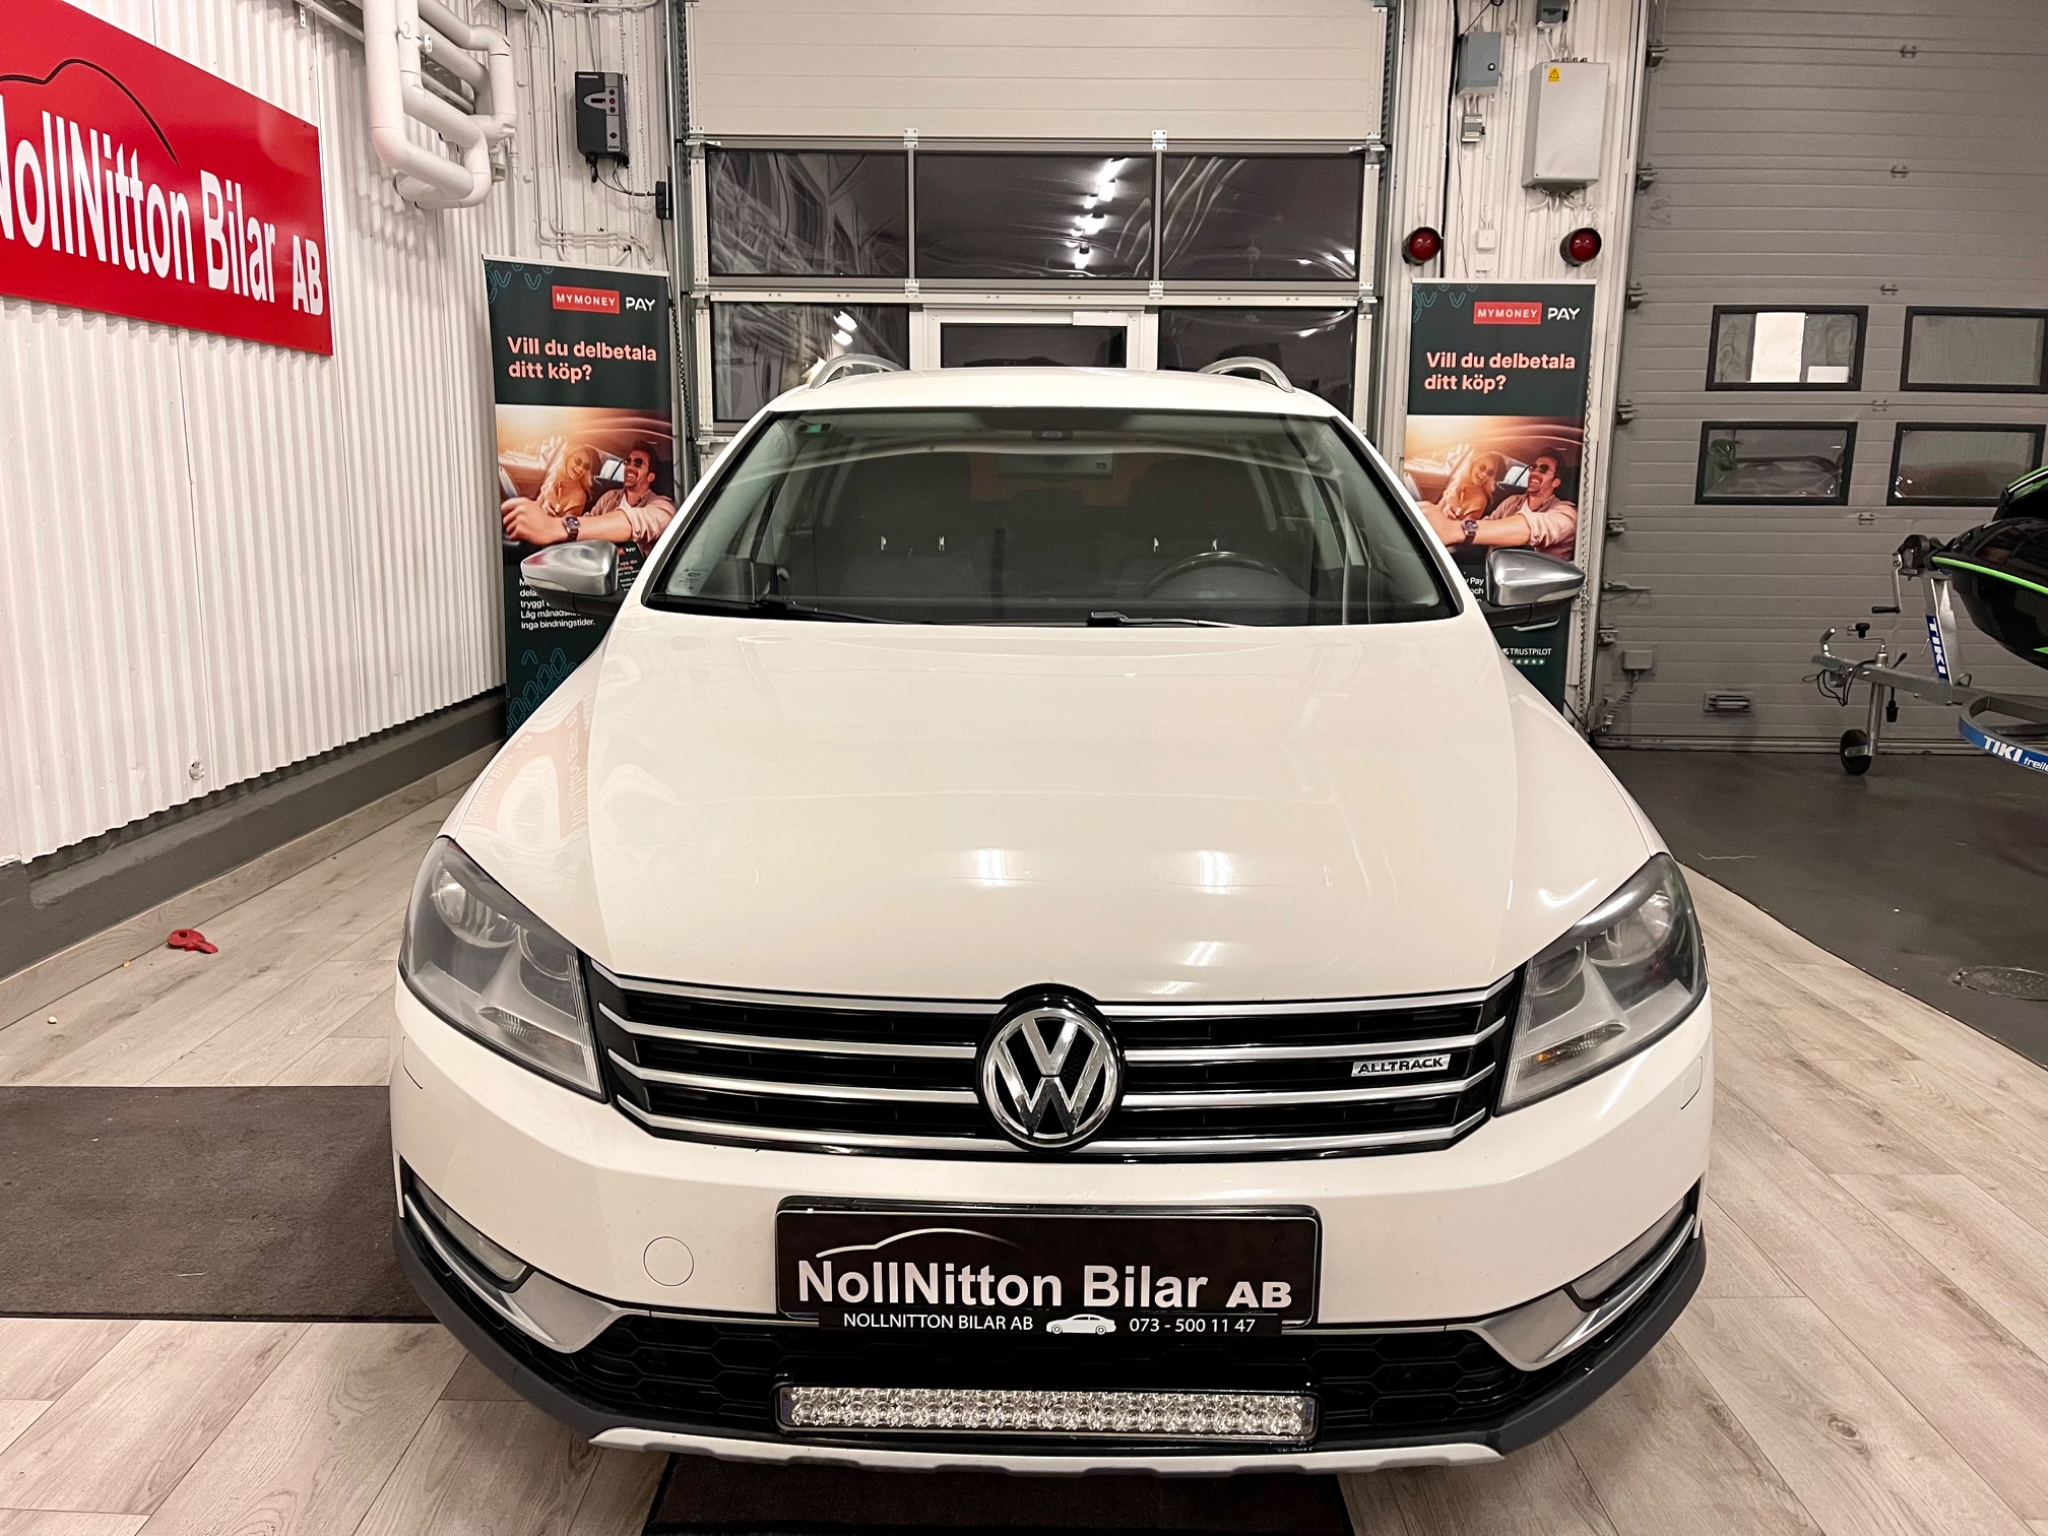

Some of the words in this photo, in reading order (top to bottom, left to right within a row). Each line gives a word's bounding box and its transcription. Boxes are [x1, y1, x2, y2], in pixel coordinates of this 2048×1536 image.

[200, 169, 277, 303] Bilar
[291, 234, 324, 316] AB
[556, 293, 616, 307] MYMONEY
[625, 296, 656, 311] PAY
[1477, 308, 1538, 318] MYMONEY
[1547, 307, 1581, 320] PAY
[507, 336, 540, 355] Vill
[544, 339, 569, 356] du
[573, 340, 657, 362] delbetala
[1426, 351, 1457, 368] Vill
[1460, 352, 1485, 368] du
[1489, 352, 1576, 369] delbetala
[508, 360, 544, 379] ditt
[548, 362, 593, 384] köp?
[1424, 374, 1458, 390] ditt
[1462, 374, 1507, 394] köp?
[1470, 576, 1485, 587] Pay
[520, 600, 545, 609] tryggt
[520, 610, 536, 620] Låg
[521, 621, 539, 631] inga
[540, 618, 596, 629] bindningstider.
[1510, 647, 1553, 656] TRUSTPILOT
[1929, 617, 1947, 674] TIKI
[1984, 735, 2023, 762] TIKI
[1357, 1057, 1444, 1074] ALLTRACK
[798, 1260, 1062, 1306] NollNitton
[1084, 1265, 1209, 1308] Bilar
[1225, 1281, 1292, 1308] AB
[844, 1313, 954, 1329] NOLLNITTON
[958, 1315, 1006, 1330] BILAR
[1010, 1316, 1034, 1331] AB
[1129, 1318, 1160, 1333] 073
[1174, 1318, 1206, 1333] 500
[1211, 1319, 1228, 1333] 11
[1234, 1319, 1256, 1333] 47
